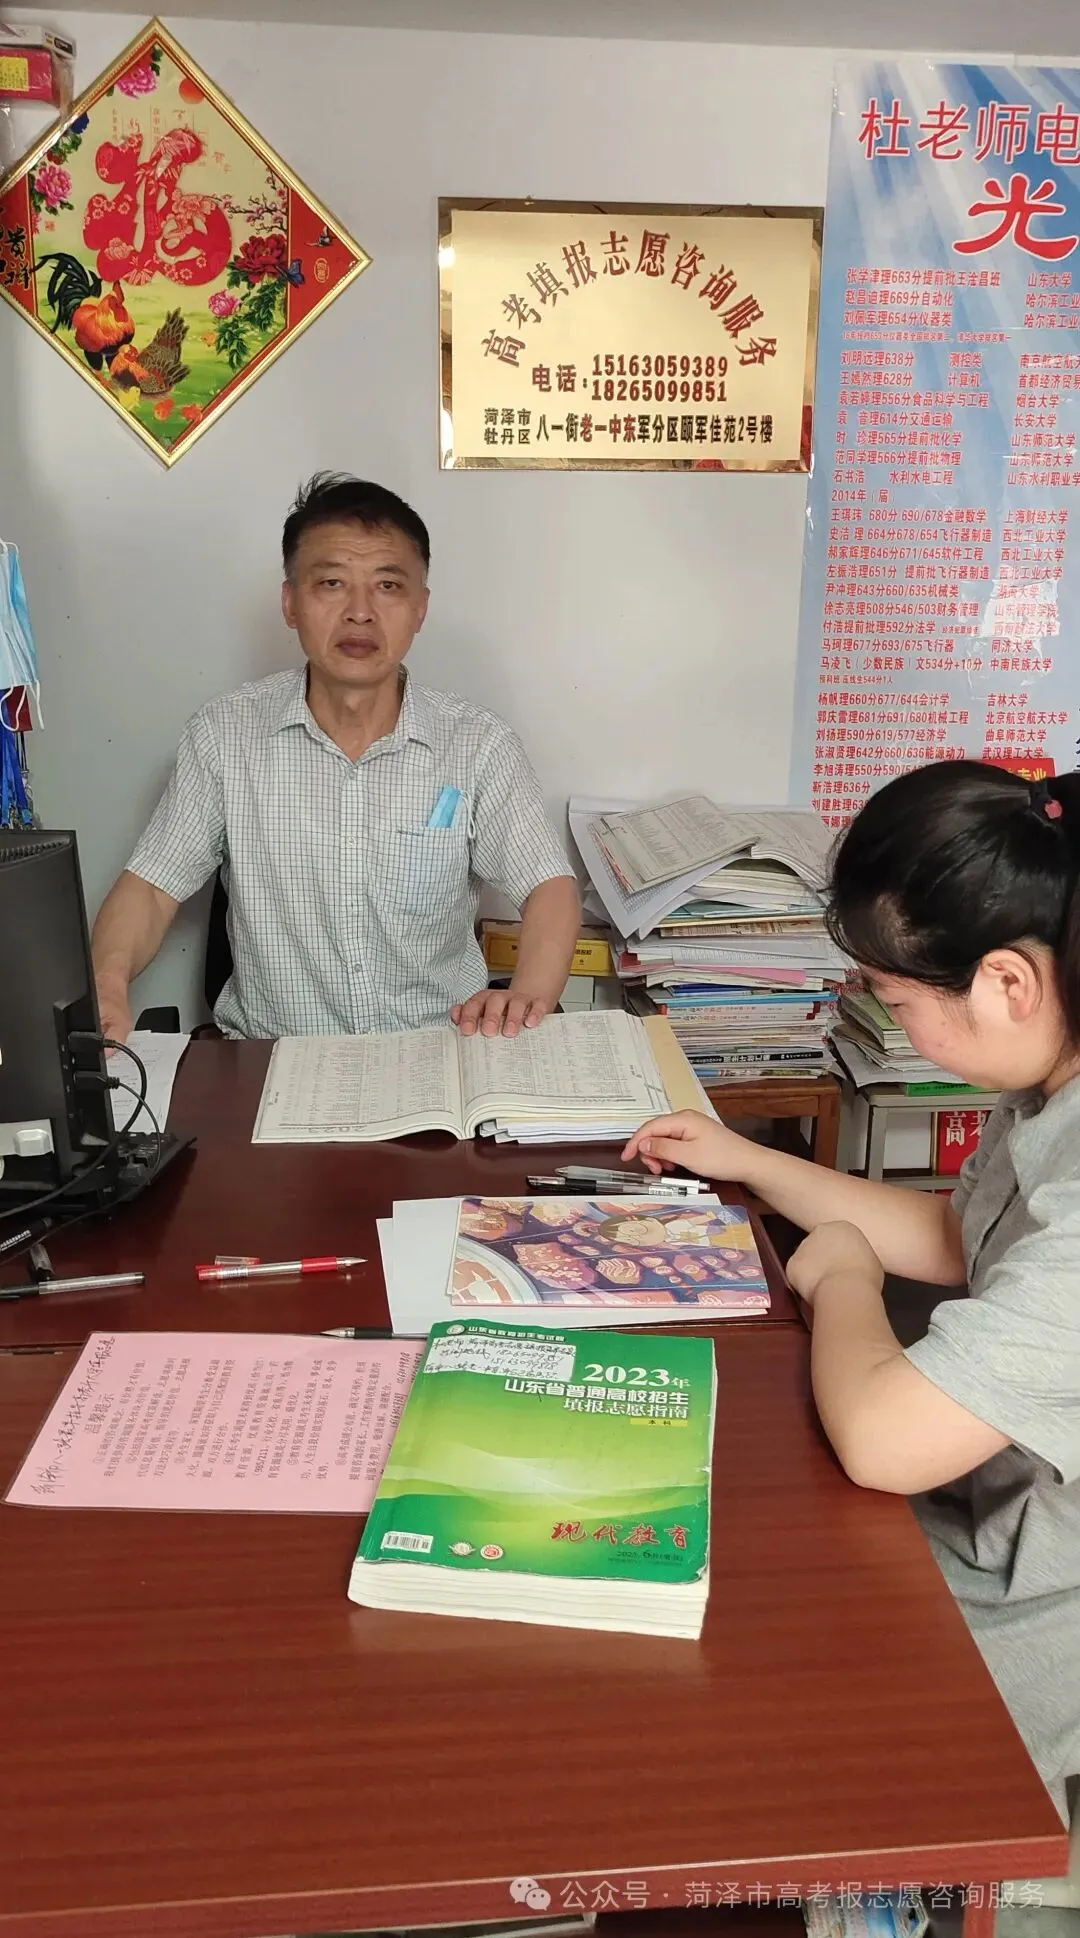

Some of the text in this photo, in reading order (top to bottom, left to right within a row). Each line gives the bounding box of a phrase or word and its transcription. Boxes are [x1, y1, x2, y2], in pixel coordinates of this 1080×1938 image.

[858, 99, 1080, 166] 杜老师电
[952, 173, 1079, 260] 光
[1028, 272, 1072, 288] 山东大学
[481, 229, 778, 367] 高考填报志愿咨询服务
[592, 355, 728, 377] 15163059389
[841, 352, 914, 369] 刘明远理638分
[950, 352, 982, 368] 测控类
[948, 372, 981, 388] 计算机
[591, 380, 728, 402] 18265099851
[1016, 394, 1060, 408] 烟台大学
[484, 408, 532, 426] 菏泽市
[1014, 413, 1057, 428] 长安大学
[536, 412, 774, 444] 八一街老一中东军分区颐军佳苑2号楼
[483, 427, 532, 446] 牡丹区
[1011, 432, 1076, 448] 山东师范大学
[889, 470, 953, 485] 水利水电工程
[869, 508, 897, 522] 680分
[1004, 509, 1068, 525] 上海财经大学
[1003, 529, 1066, 545] 西北工业大学
[1001, 547, 1064, 562] 西北工业大学
[991, 640, 1033, 654] 同济大学
[990, 657, 1052, 672] 中南民族大学
[987, 693, 1028, 707] 吉林大学
[985, 711, 1068, 725] 北京航空航天大学
[985, 729, 1047, 743] 曲阜师范大学
[982, 746, 1044, 760] 武汉理工大学
[814, 763, 924, 777] 李旭涛理550分590/5
[1007, 768, 1047, 782] 专业
[583, 1363, 691, 1389] 2023年
[504, 1379, 689, 1405] 山东省普通高校招生
[563, 1398, 688, 1419] 填报志愿指南
[551, 1521, 690, 1549] 现代教育
